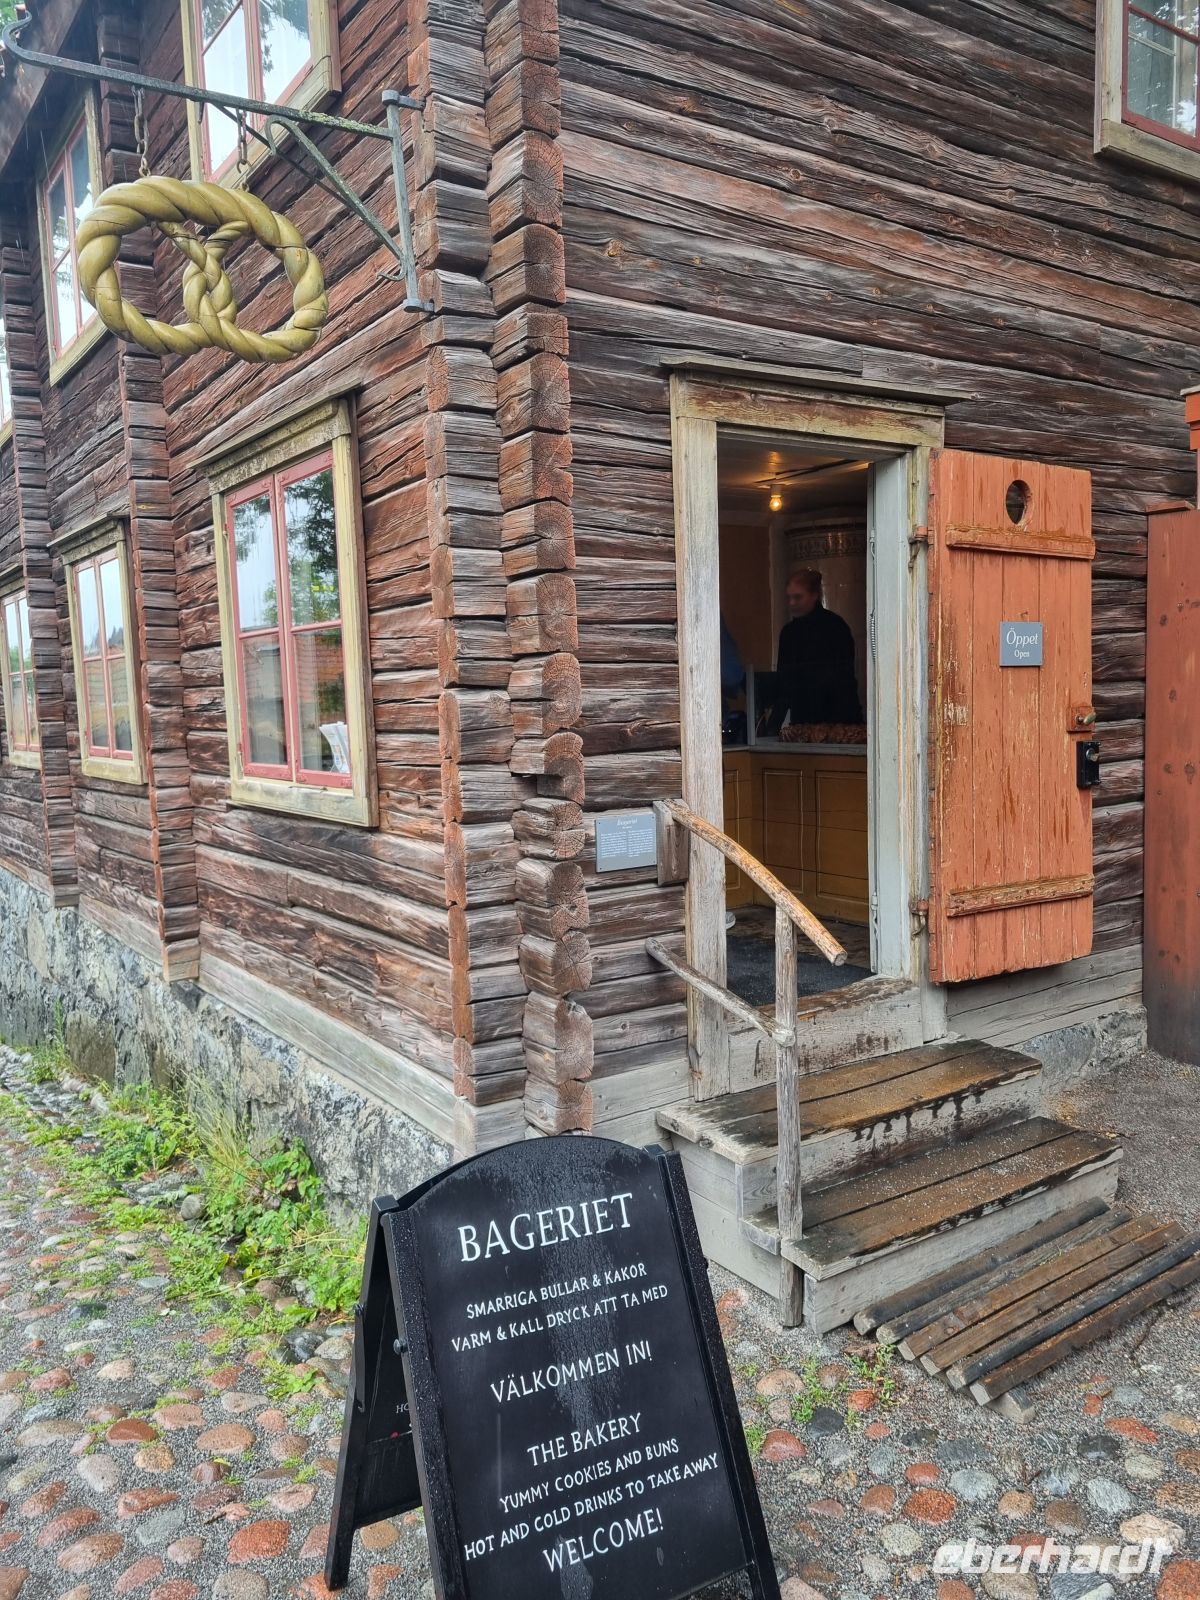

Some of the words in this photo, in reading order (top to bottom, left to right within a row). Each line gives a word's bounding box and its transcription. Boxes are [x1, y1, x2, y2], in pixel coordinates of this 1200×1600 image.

[1006, 625, 1039, 648] Öppet
[1014, 649, 1030, 660] Open
[458, 1192, 633, 1263] BAGERIET
[451, 1329, 492, 1353] VARM
[496, 1325, 508, 1341] &
[508, 1317, 544, 1338] KALL
[546, 1304, 591, 1328] DRYCK
[593, 1296, 618, 1317] ATT
[620, 1292, 640, 1308] TA
[641, 1284, 668, 1304] MED
[466, 1289, 538, 1320] SMARRIGA
[539, 1276, 590, 1301] BULLAR
[592, 1273, 602, 1288] &
[603, 1262, 648, 1285] KAKOR
[490, 1347, 620, 1403] VÄLKOMMEN
[625, 1340, 653, 1366] IN!
[526, 1436, 569, 1467] THE
[570, 1413, 641, 1453] BAKERY
[499, 1481, 549, 1513] YUMMY
[554, 1460, 612, 1492] COOKIES
[615, 1450, 642, 1473] AND
[645, 1438, 679, 1461] BUNS
[463, 1534, 495, 1561] HOT
[500, 1523, 530, 1548] AND
[534, 1506, 571, 1533] COLD
[573, 1486, 623, 1517] DRINKS
[624, 1479, 645, 1499] TO
[542, 1508, 664, 1573] WELCOME!
